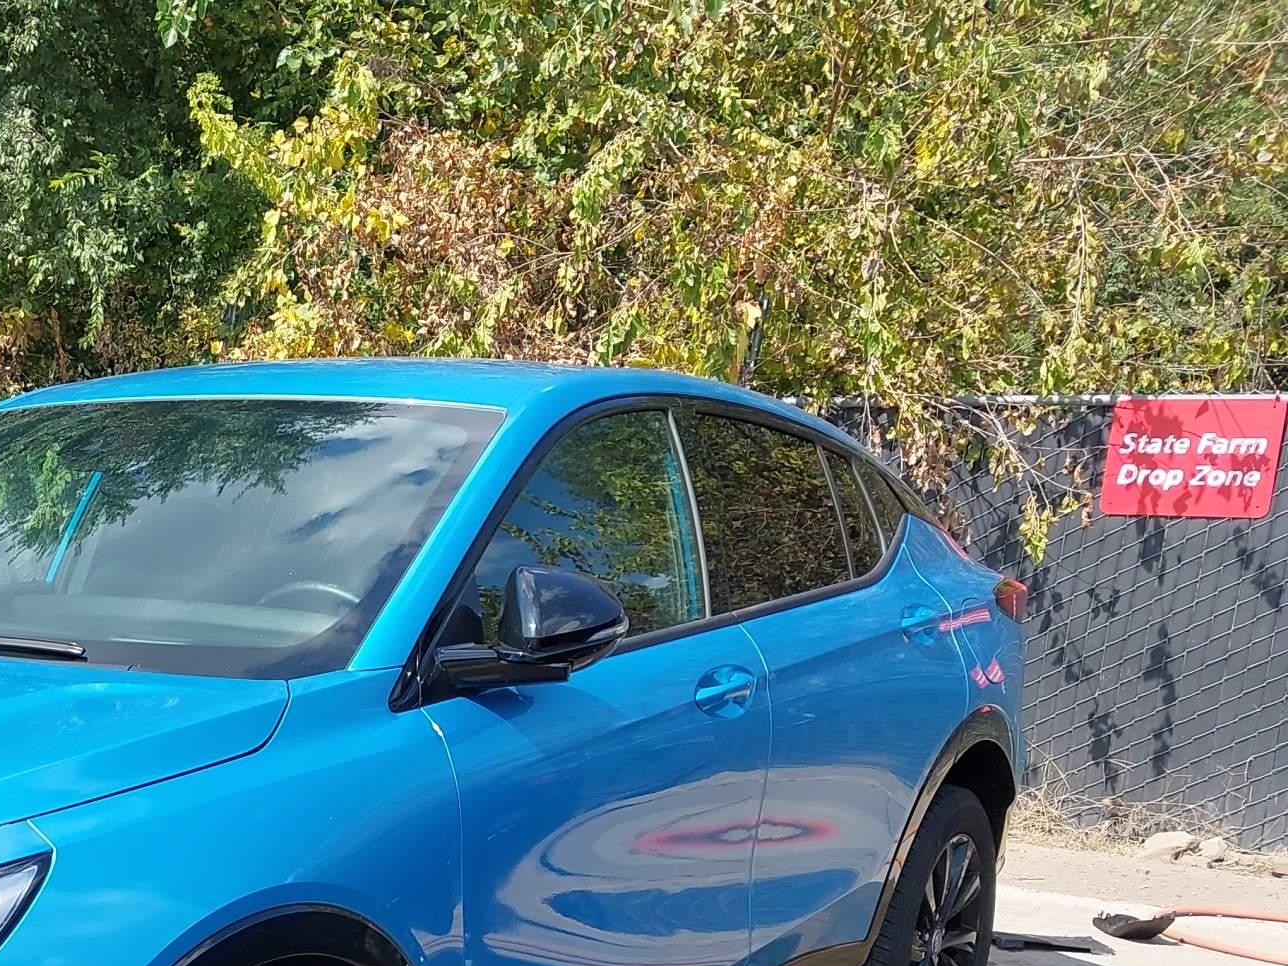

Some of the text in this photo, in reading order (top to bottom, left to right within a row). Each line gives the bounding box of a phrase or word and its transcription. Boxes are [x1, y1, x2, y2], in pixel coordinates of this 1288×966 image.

[1119, 432, 1269, 456] State Farm
[1116, 463, 1262, 490] Drop Zone
